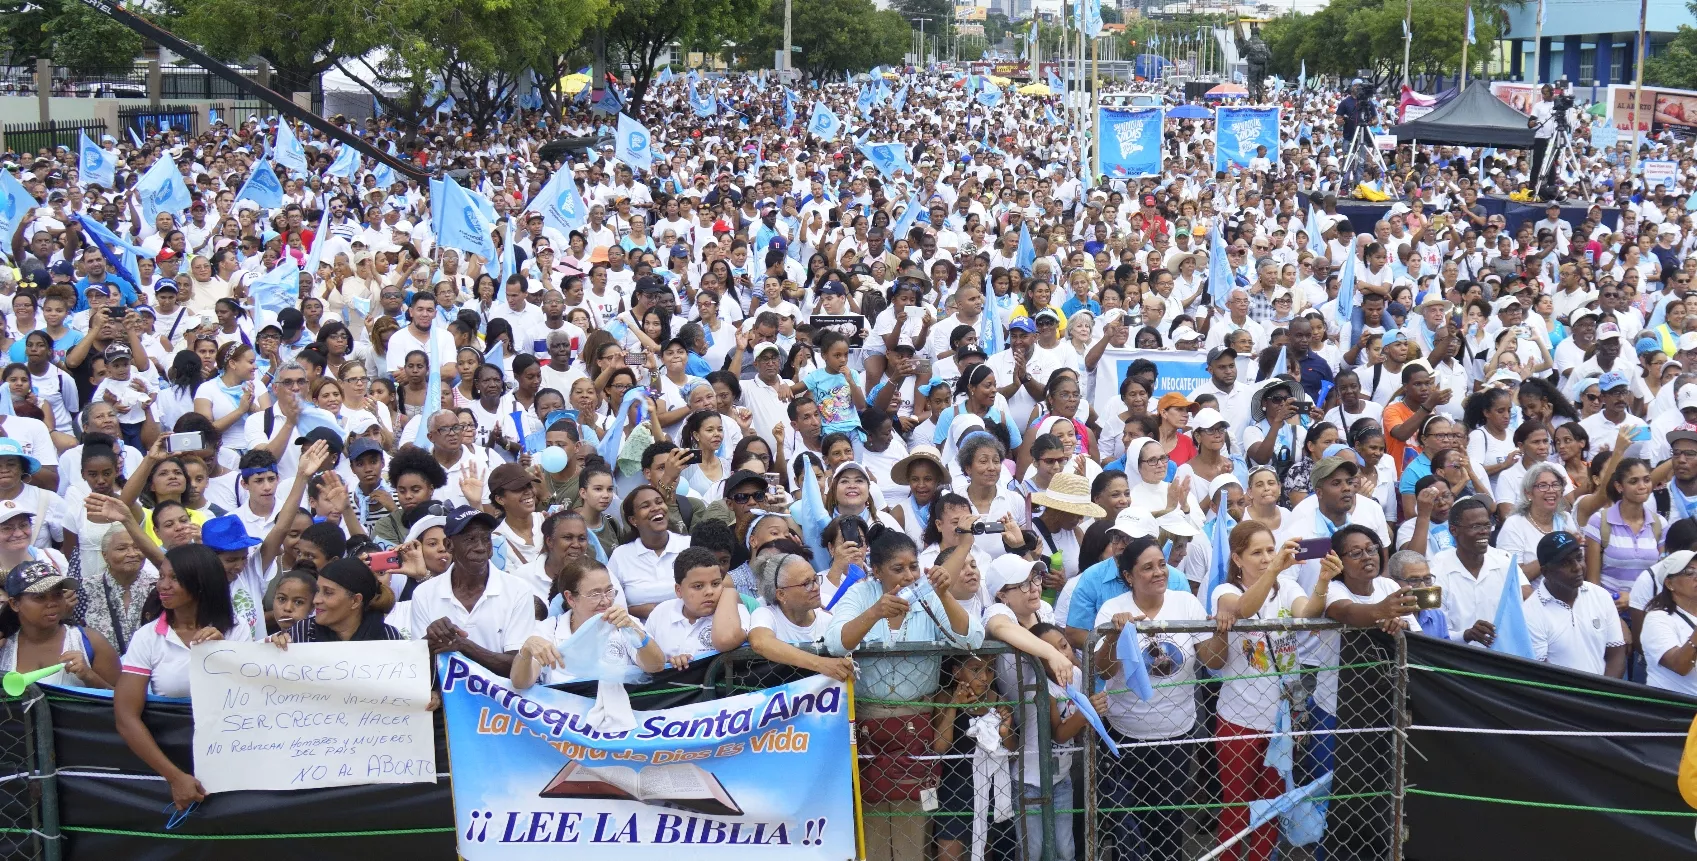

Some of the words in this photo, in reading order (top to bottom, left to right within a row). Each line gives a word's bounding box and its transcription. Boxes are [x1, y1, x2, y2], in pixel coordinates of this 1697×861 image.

[1626, 103, 1652, 111] ABRTO
[1629, 121, 1650, 131] VDA
[222, 686, 250, 710] NO
[358, 710, 411, 728] HACER
[636, 706, 754, 740] Santa
[758, 685, 841, 729] Ana
[206, 742, 223, 756] NO
[352, 734, 413, 747] MUJERES
[477, 708, 510, 734] La
[652, 748, 712, 765] Dios
[291, 765, 328, 785] NO
[338, 763, 353, 777] AL
[366, 754, 435, 778] ABORTO
[498, 811, 583, 843] LEE
[589, 812, 641, 843] LA
[650, 813, 792, 845] BIBLIA
[802, 817, 827, 846] !!
